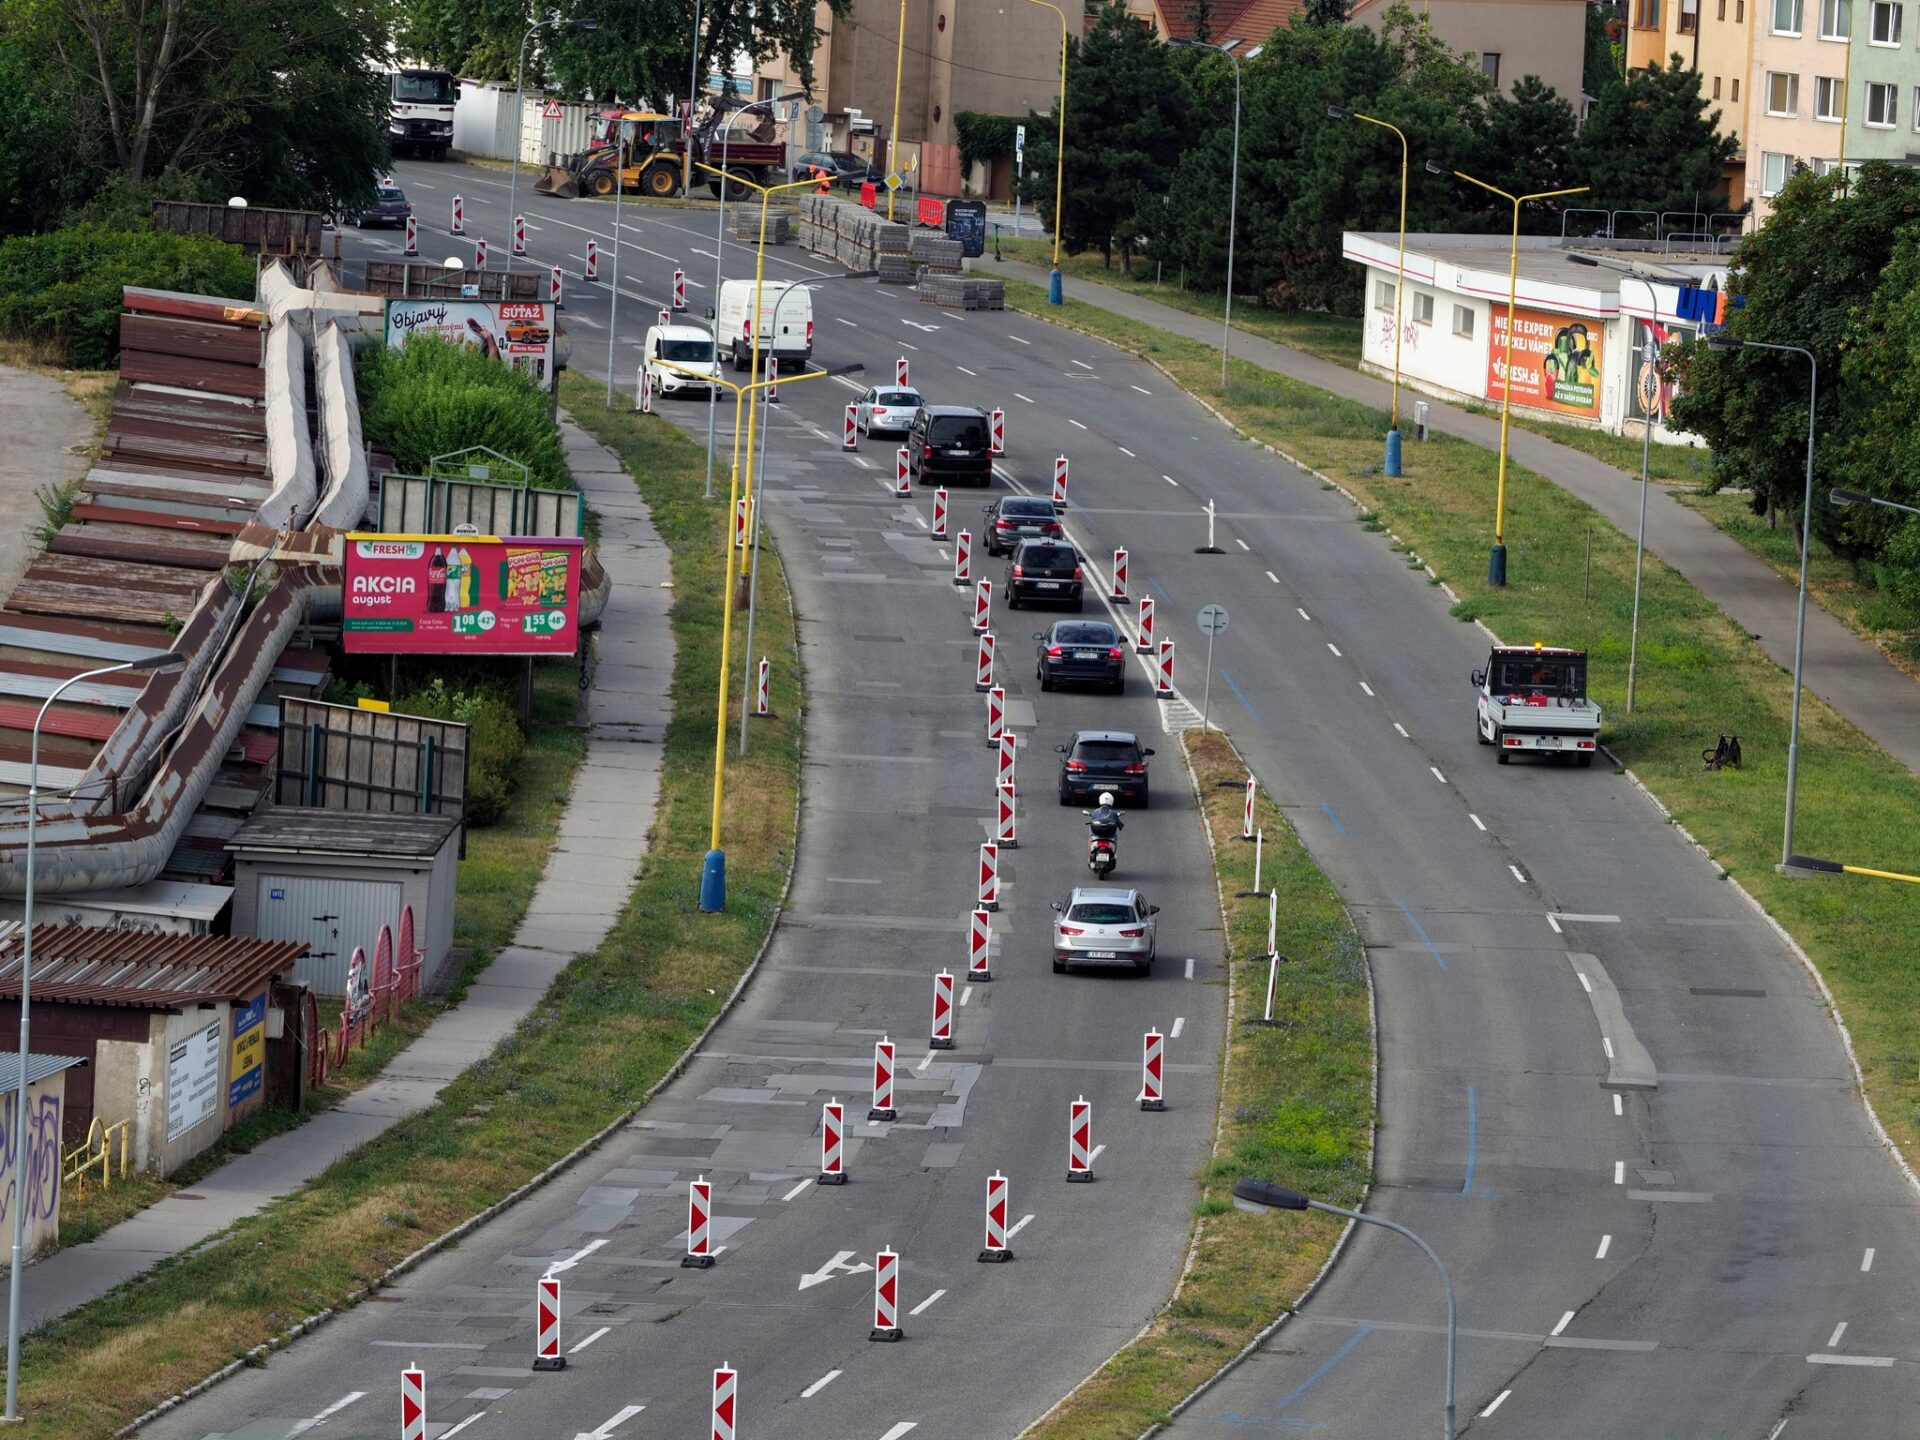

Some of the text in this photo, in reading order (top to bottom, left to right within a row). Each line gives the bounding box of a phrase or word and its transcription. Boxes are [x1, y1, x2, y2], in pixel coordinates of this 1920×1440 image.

[392, 303, 448, 332] Objavuj
[502, 304, 540, 318] SÚŤAŽ
[1494, 316, 1508, 330] NIE
[1524, 321, 1554, 337] EXPERT
[1494, 333, 1499, 346] V
[373, 545, 405, 554] FRESH
[353, 576, 415, 593] AKCIA
[352, 595, 392, 606] august
